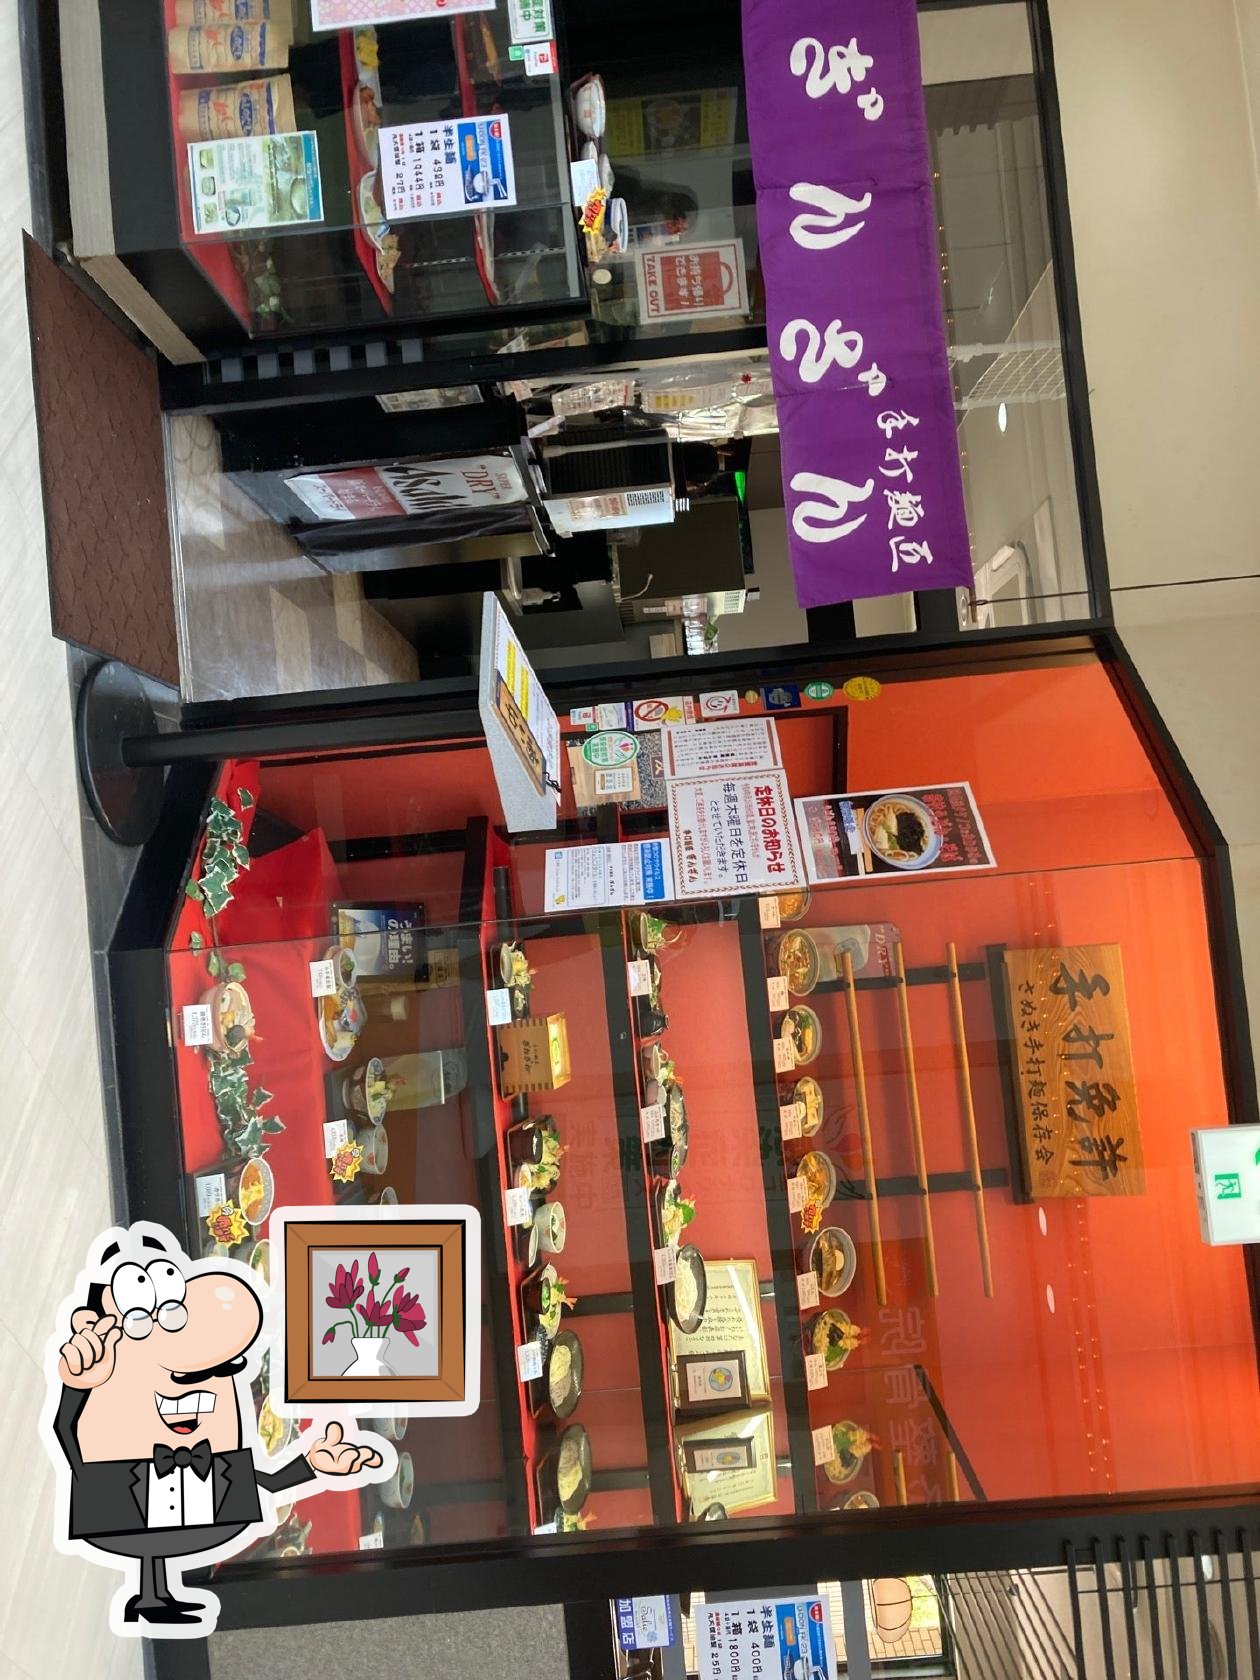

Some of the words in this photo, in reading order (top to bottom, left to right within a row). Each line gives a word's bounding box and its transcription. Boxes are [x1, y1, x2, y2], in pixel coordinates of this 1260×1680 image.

[442, 125, 457, 164] 半生麺
[413, 158, 425, 190] 1944円
[433, 159, 445, 187] 432円
[646, 255, 658, 286] TAKE
[779, 37, 885, 543] ぎんざん
[648, 290, 660, 314] OUT
[383, 466, 473, 511] Asahi
[461, 464, 500, 500] "DRY"
[494, 473, 513, 490] SUPER
[876, 410, 933, 572] 手打麺匠
[710, 800, 729, 878] とさせていただきます。
[723, 782, 748, 883] 毎週木曜日を定休日
[754, 785, 785, 873] 定休日のお知らせ
[686, 854, 699, 883] ぎんざん
[387, 919, 400, 970] の理由。
[400, 920, 414, 964] うまい!
[1018, 980, 1055, 1165] さぬき手打麺保存会
[1049, 963, 1128, 1181] 手打免許
[618, 1600, 635, 1645] 加盟店
[732, 1622, 743, 1635] 箱
[747, 1620, 759, 1634] 袋
[760, 1606, 775, 1648] 半生麺
[711, 1652, 722, 1675] 25円
[728, 1638, 741, 1673] 1800円
[751, 1642, 763, 1673] 400円
